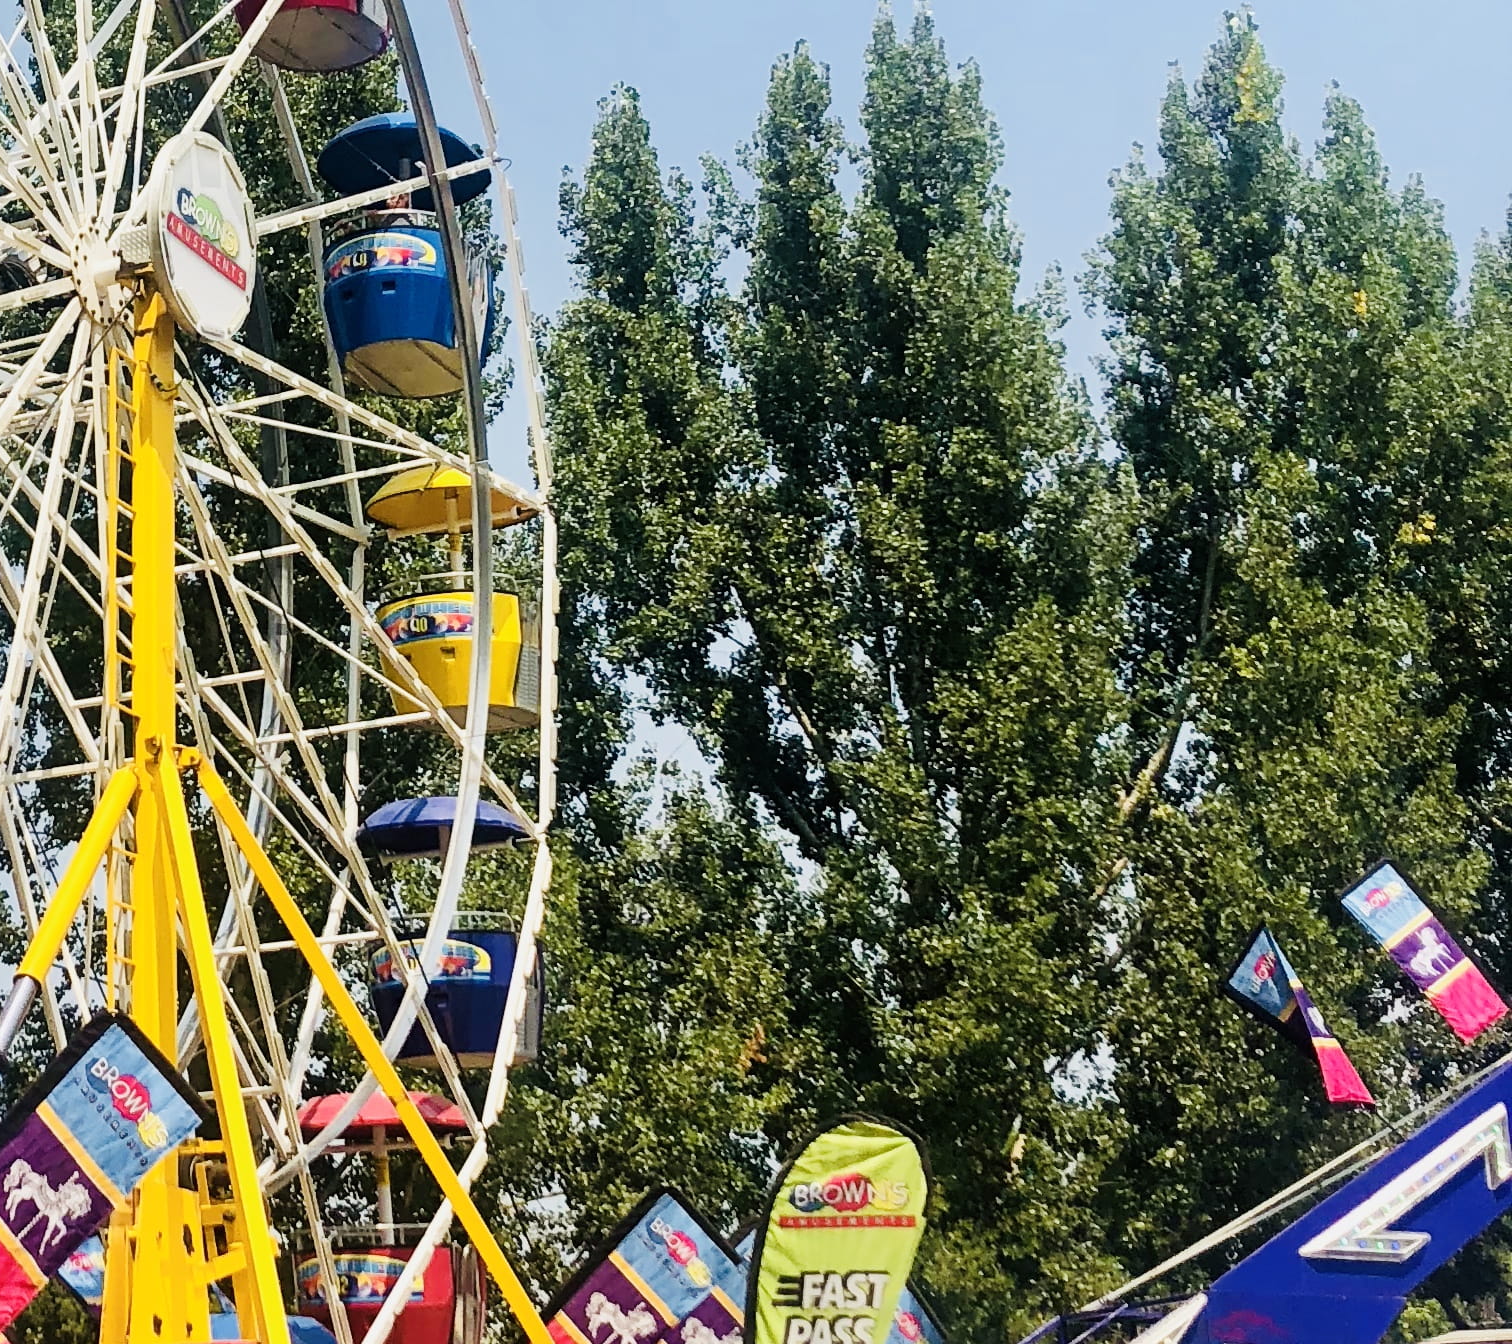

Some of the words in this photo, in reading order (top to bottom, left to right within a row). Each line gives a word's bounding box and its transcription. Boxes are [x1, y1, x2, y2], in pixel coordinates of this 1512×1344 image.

[168, 214, 244, 286] AMUSEMENTS
[794, 1179, 908, 1207] BROWN'S
[800, 1270, 890, 1309] FAST
